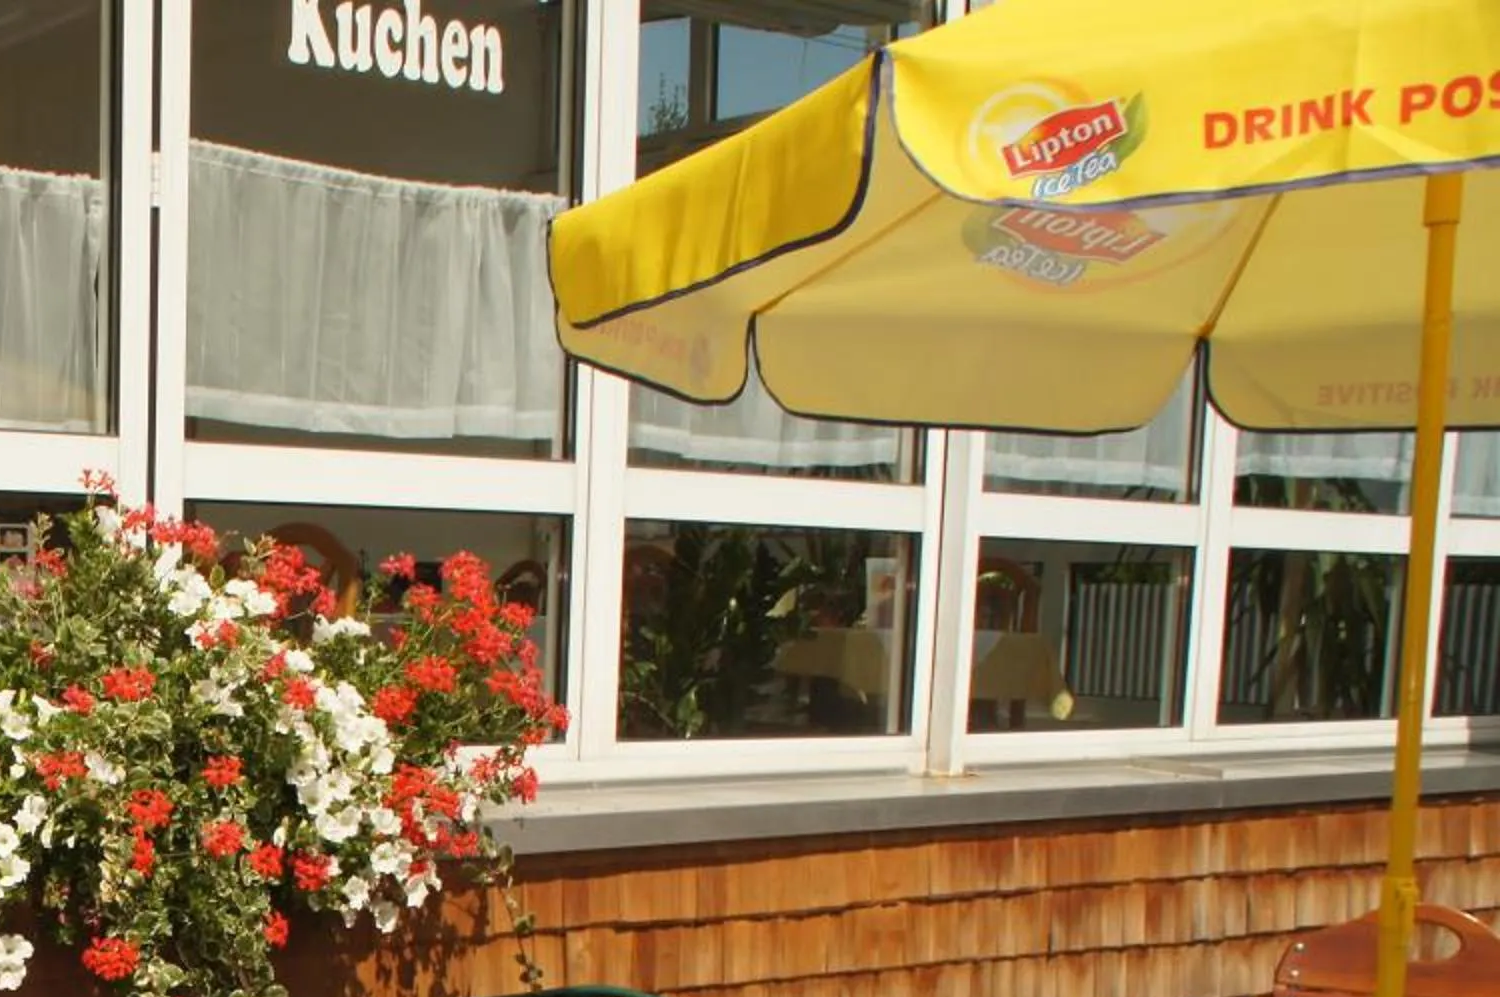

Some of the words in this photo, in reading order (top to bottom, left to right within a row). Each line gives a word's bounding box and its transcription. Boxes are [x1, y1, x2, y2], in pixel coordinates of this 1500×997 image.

[287, 0, 504, 94] Kuchen
[1011, 113, 1115, 169] Lipton
[1204, 88, 1375, 149] DRINK
